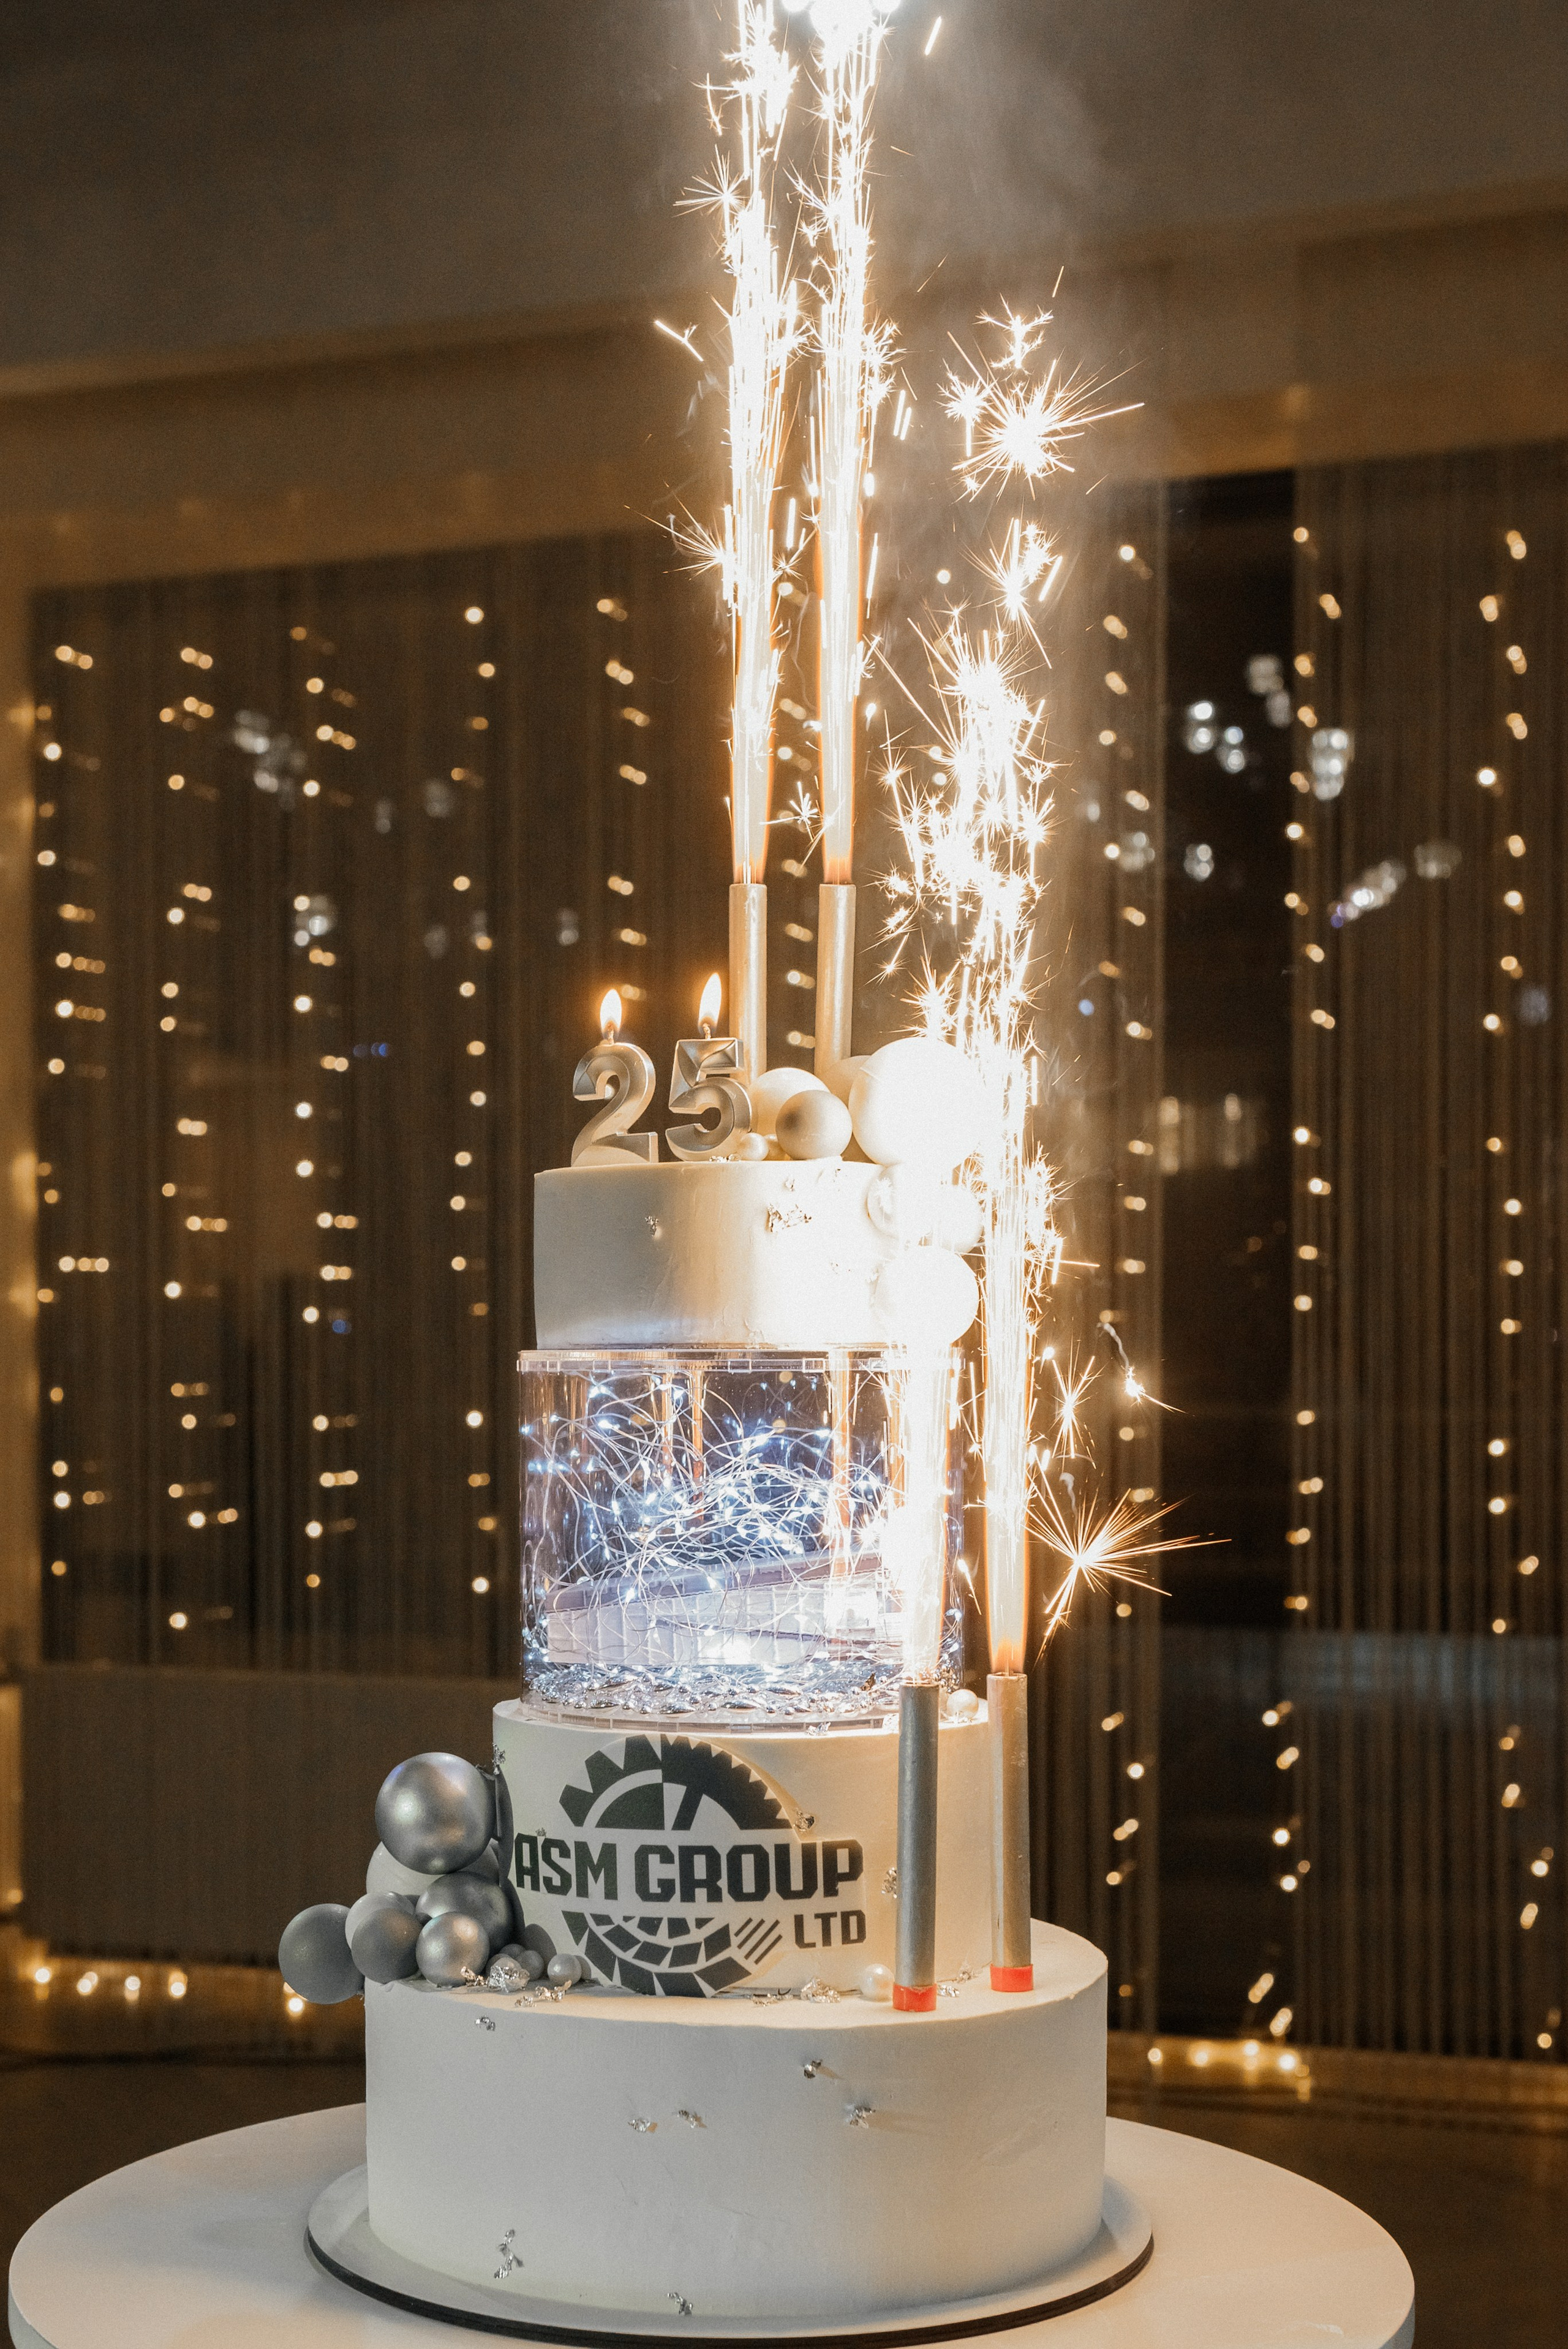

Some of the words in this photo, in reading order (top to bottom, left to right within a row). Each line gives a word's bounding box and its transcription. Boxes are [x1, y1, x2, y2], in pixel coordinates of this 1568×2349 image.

[571, 1038, 753, 1167] 25
[514, 1833, 618, 1900] ASM
[634, 1839, 864, 1903] GROUP
[794, 1910, 867, 1949] LTD
